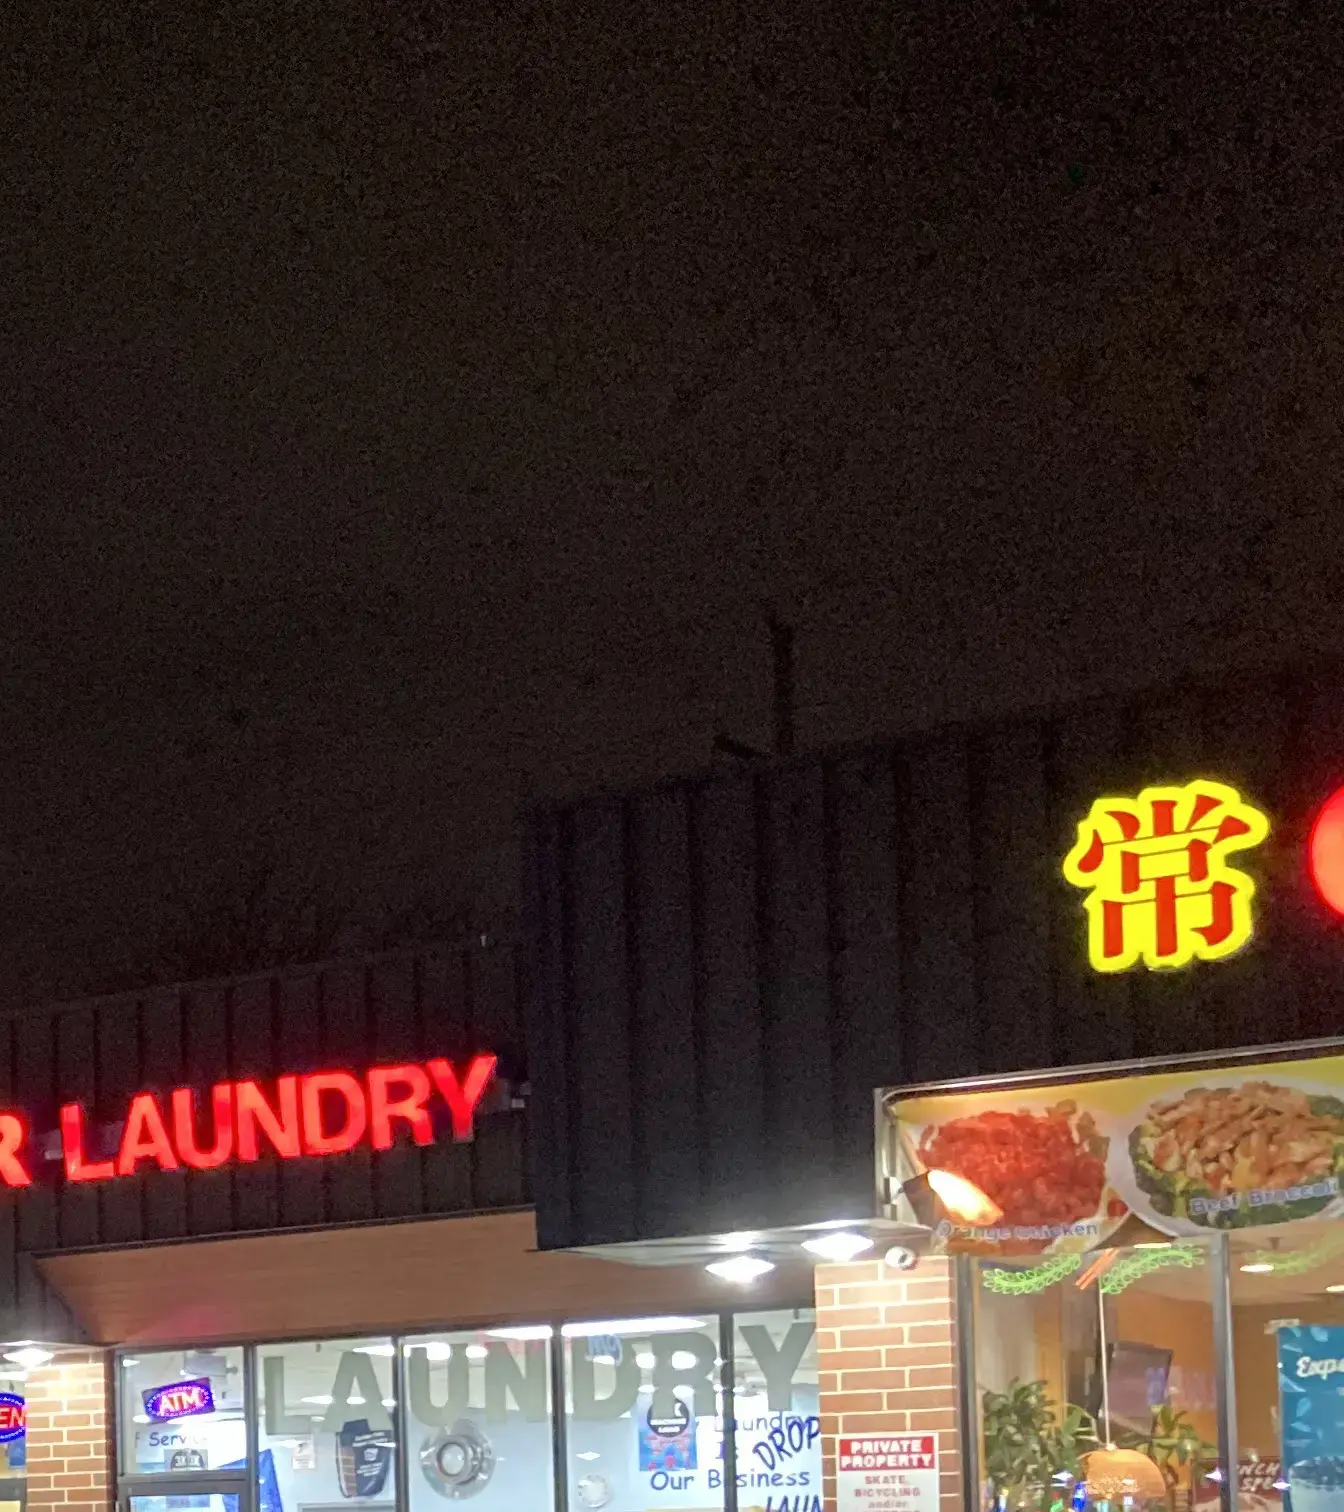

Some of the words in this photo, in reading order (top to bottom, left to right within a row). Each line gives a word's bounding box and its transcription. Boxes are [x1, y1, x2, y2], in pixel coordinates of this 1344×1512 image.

[59, 1053, 498, 1183] LAUNDRY
[264, 1321, 818, 1435] LAUNDRY
[158, 1387, 202, 1416] ATM
[850, 1438, 923, 1455] PRIVATE
[840, 1453, 933, 1468] PROPERTY
[649, 1470, 695, 1491] Our
[707, 1468, 811, 1489] Bsiness
[853, 1487, 921, 1498] BICYCLING
